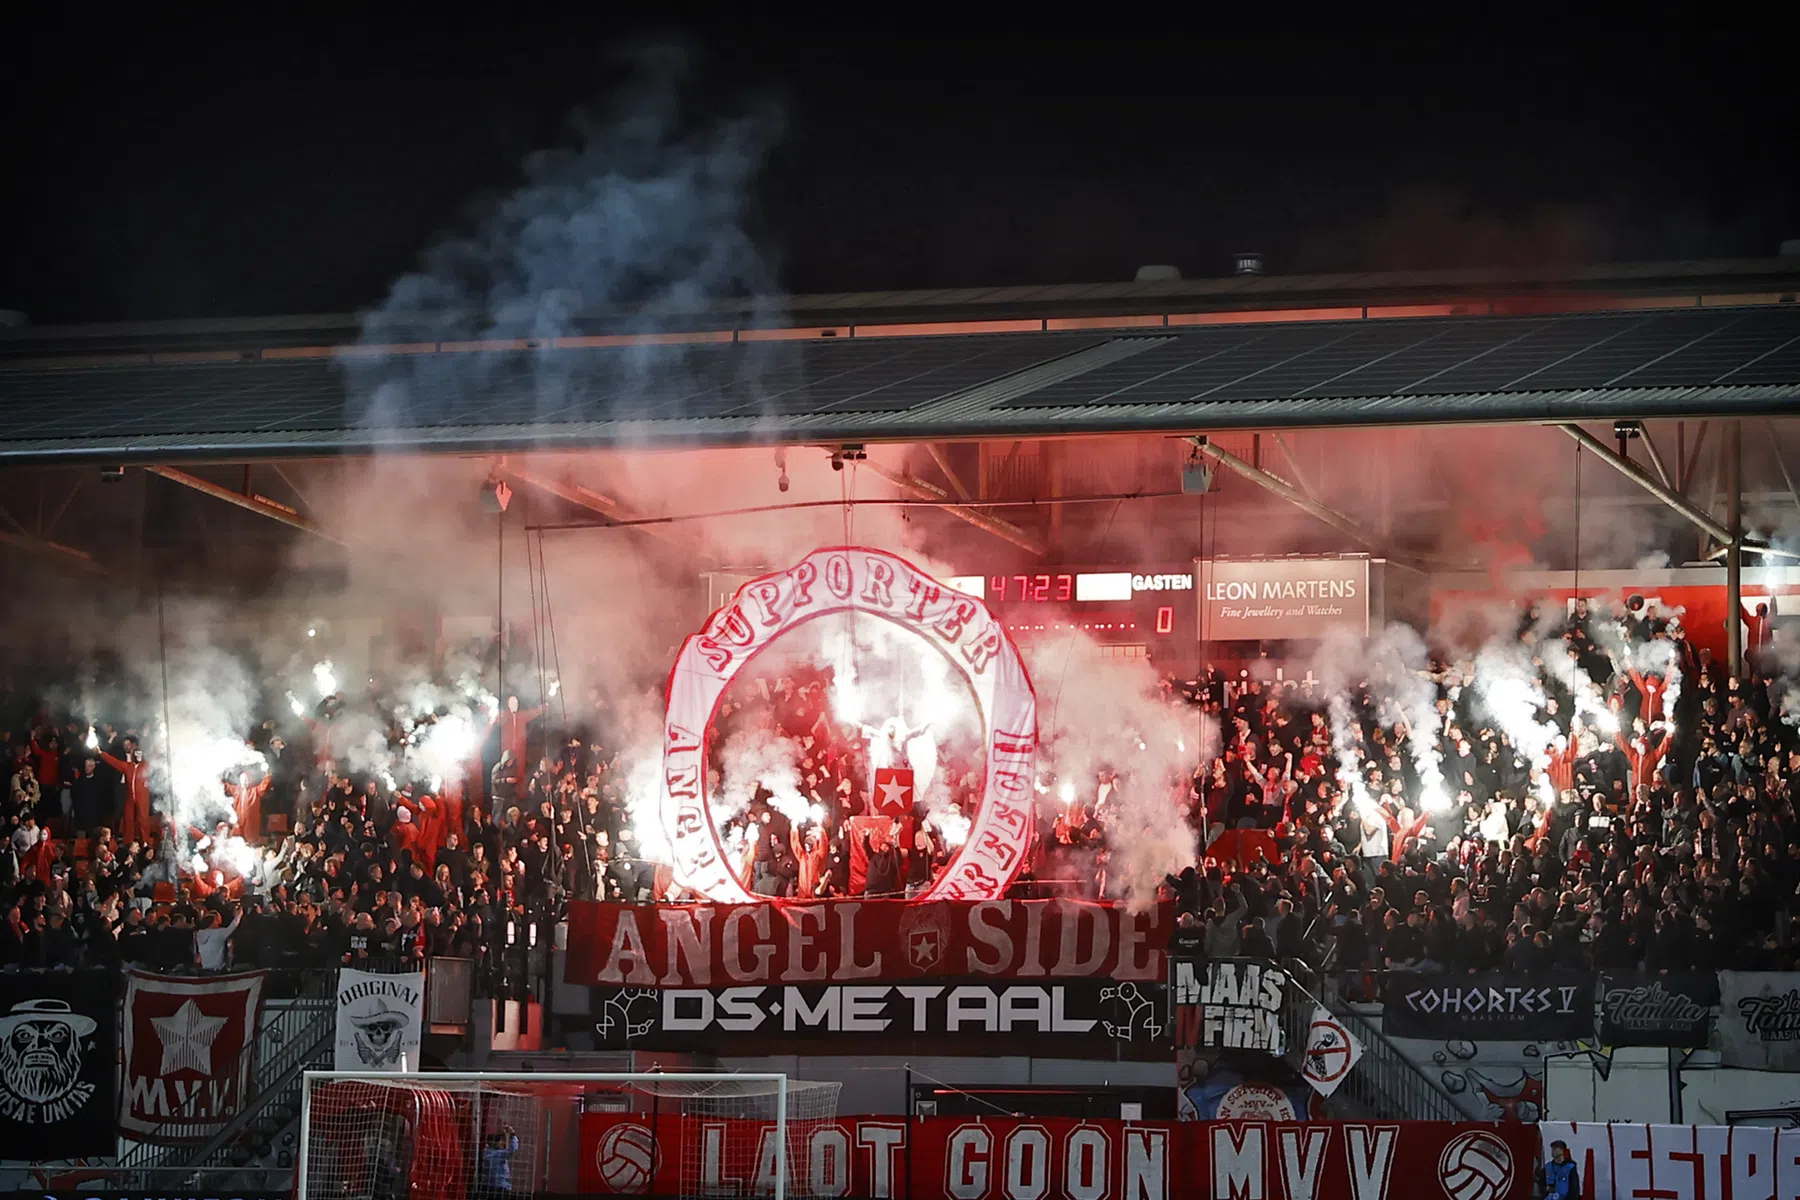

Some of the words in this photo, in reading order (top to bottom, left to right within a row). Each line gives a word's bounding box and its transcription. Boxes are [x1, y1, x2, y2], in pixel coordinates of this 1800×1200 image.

[991, 574, 1072, 602] 47:23
[1132, 574, 1192, 590] GASTEN
[1206, 581, 1257, 600] LEON
[1262, 580, 1356, 599] MARTENS
[697, 554, 1001, 675] SUPPORTER
[1156, 606, 1172, 633] 0
[1220, 604, 1243, 619] Fine
[1243, 604, 1284, 620] Jewellery
[1285, 604, 1305, 618] and
[1306, 604, 1343, 616] Watches
[597, 903, 883, 986] ANGEL
[966, 899, 1163, 983] SIDE
[339, 980, 420, 1009] ORIGINAL
[1176, 961, 1286, 1012] MAAS
[1404, 986, 1552, 1014] COHORTES
[1556, 986, 1578, 1014] V
[1203, 1004, 1281, 1051] FIRM
[43, 1081, 96, 1124] UNITAS
[701, 1121, 907, 1200] LAOT
[943, 1122, 1170, 1200] GOON
[1208, 1121, 1400, 1200] MVV
